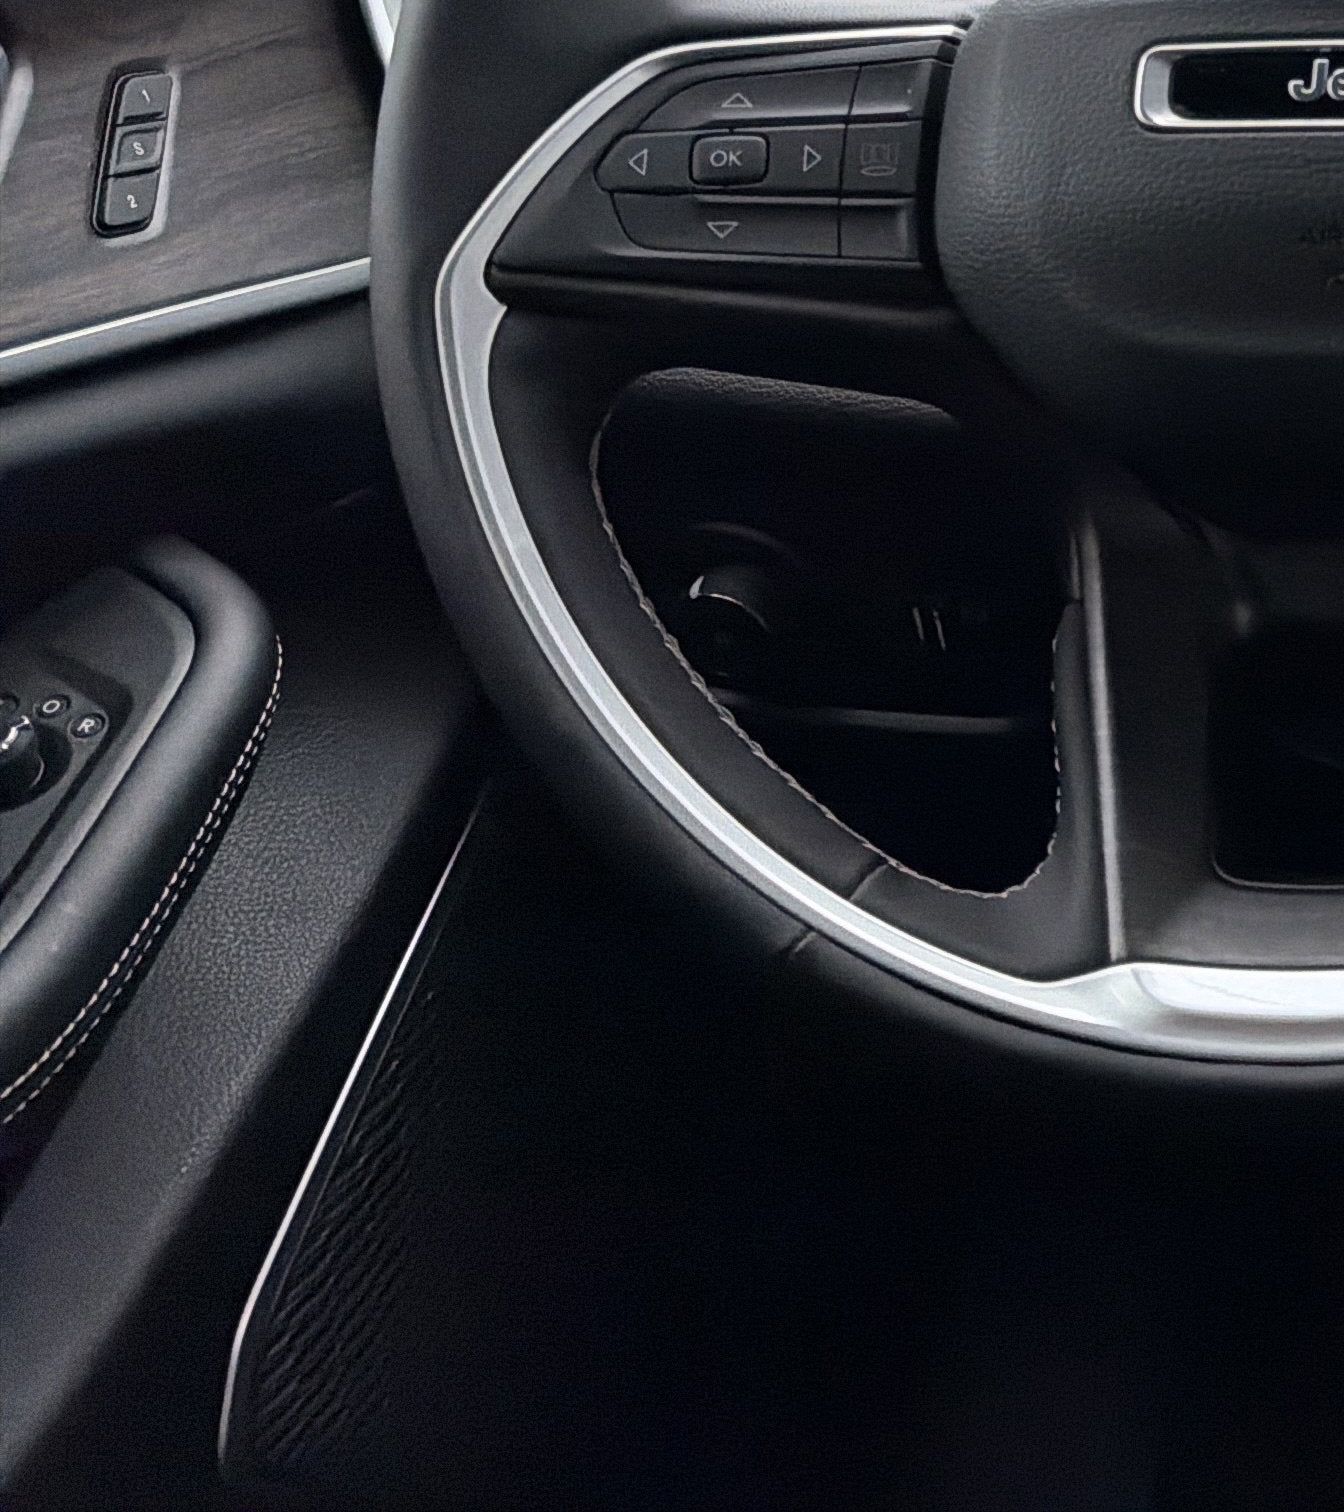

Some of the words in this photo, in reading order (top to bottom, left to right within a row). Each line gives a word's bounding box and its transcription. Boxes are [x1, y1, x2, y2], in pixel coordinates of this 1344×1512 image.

[709, 149, 744, 167] OK
[126, 194, 138, 208] 2
[76, 717, 96, 734] R
